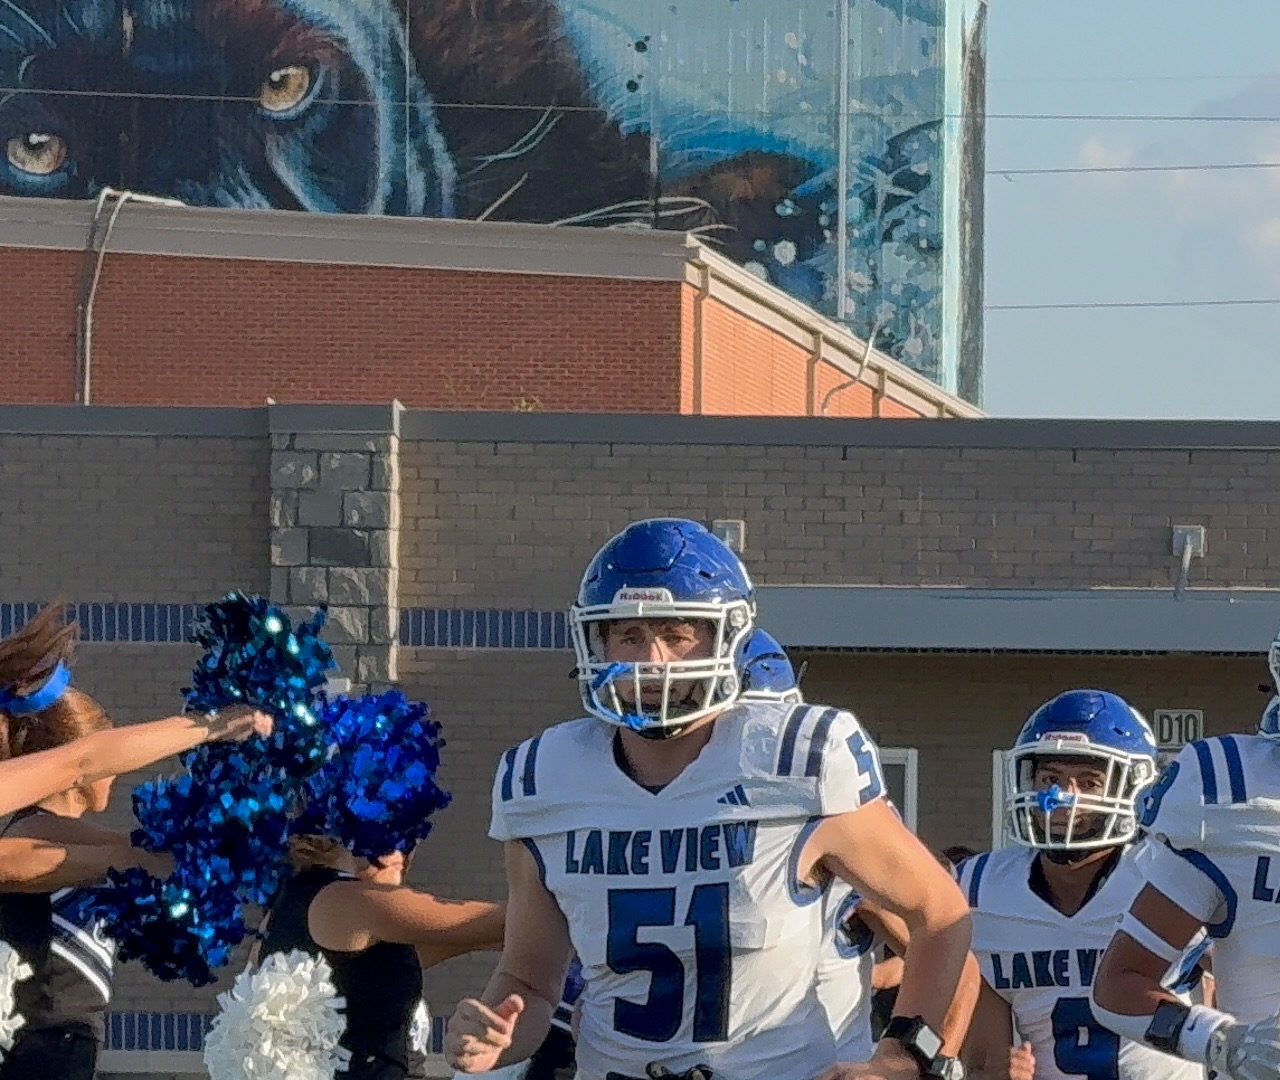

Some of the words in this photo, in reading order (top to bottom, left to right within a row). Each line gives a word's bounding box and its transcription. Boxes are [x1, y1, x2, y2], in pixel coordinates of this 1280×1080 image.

[1159, 713, 1199, 743] D10
[565, 829, 652, 875] LAKE
[660, 820, 759, 874] VIEW
[606, 881, 732, 1043] 51
[990, 949, 1070, 990] LAKE
